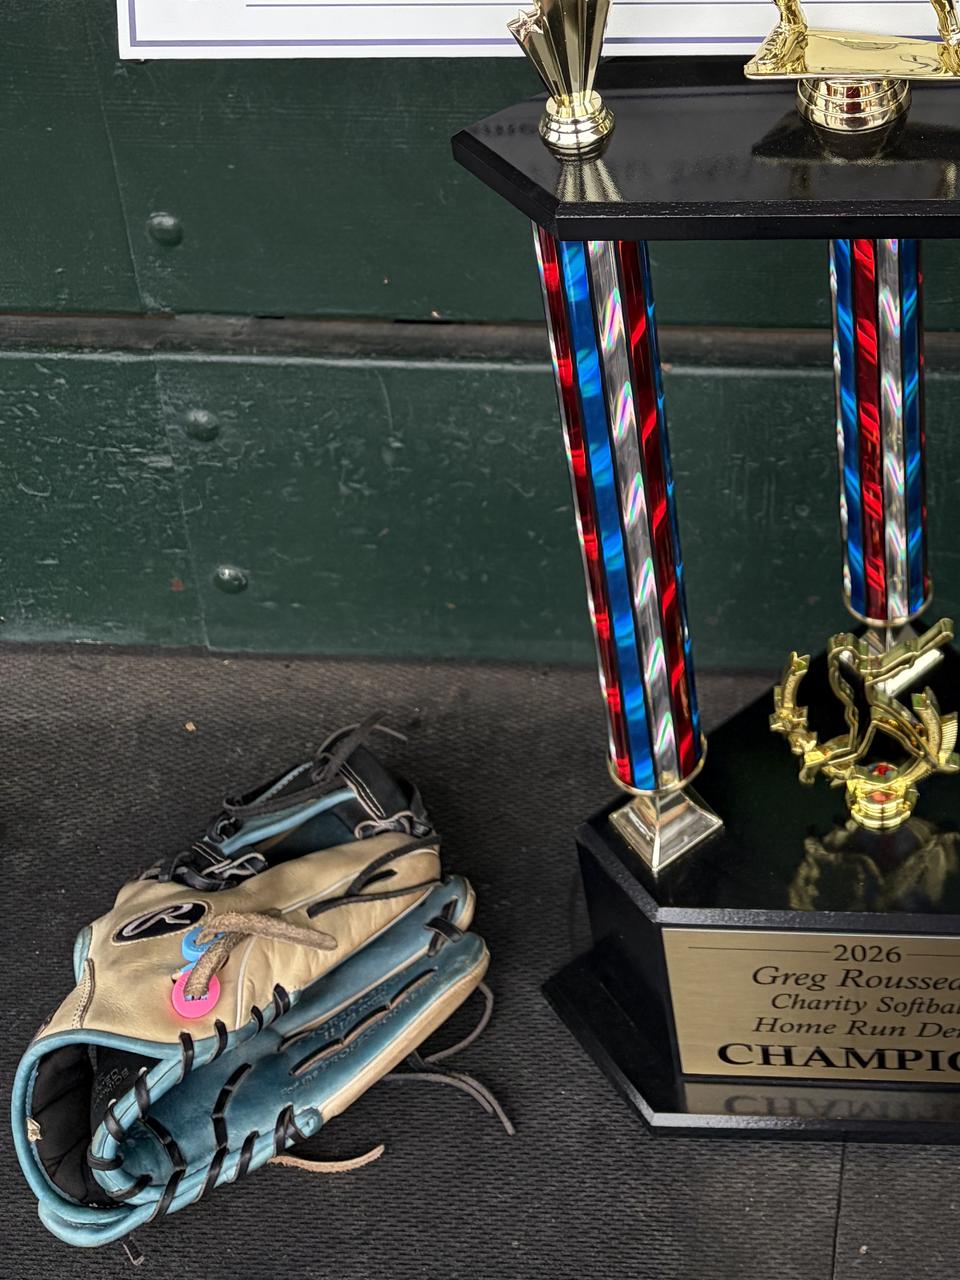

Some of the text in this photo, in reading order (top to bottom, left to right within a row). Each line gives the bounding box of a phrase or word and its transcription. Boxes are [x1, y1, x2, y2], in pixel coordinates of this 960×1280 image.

[834, 945, 901, 963] 2026
[753, 966, 828, 991] Greg
[772, 993, 868, 1015] Charity
[752, 1017, 837, 1036] Home
[846, 1020, 907, 1037] Run
